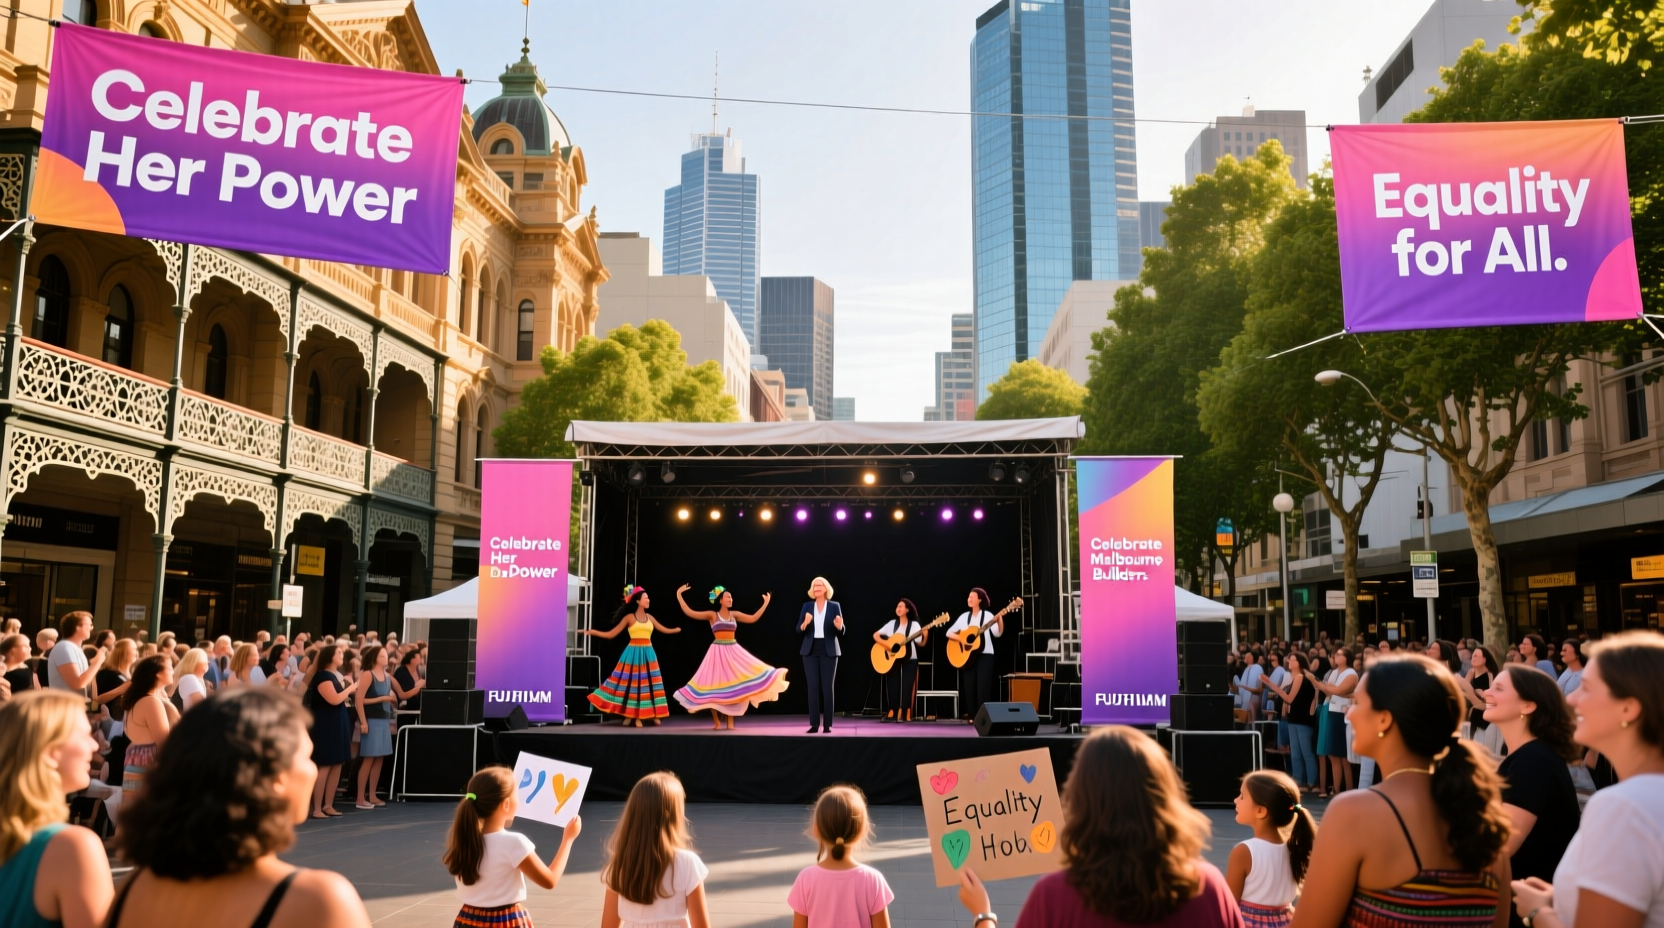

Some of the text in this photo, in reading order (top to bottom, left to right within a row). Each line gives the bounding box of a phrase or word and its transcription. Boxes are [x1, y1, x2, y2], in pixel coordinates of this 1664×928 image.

[91, 69, 413, 163] Celebrate
[83, 130, 418, 225] Her Power
[1373, 165, 1591, 230] Equality
[1391, 224, 1568, 276] for All.
[490, 551, 517, 564] Her
[943, 788, 1042, 829] Equality
